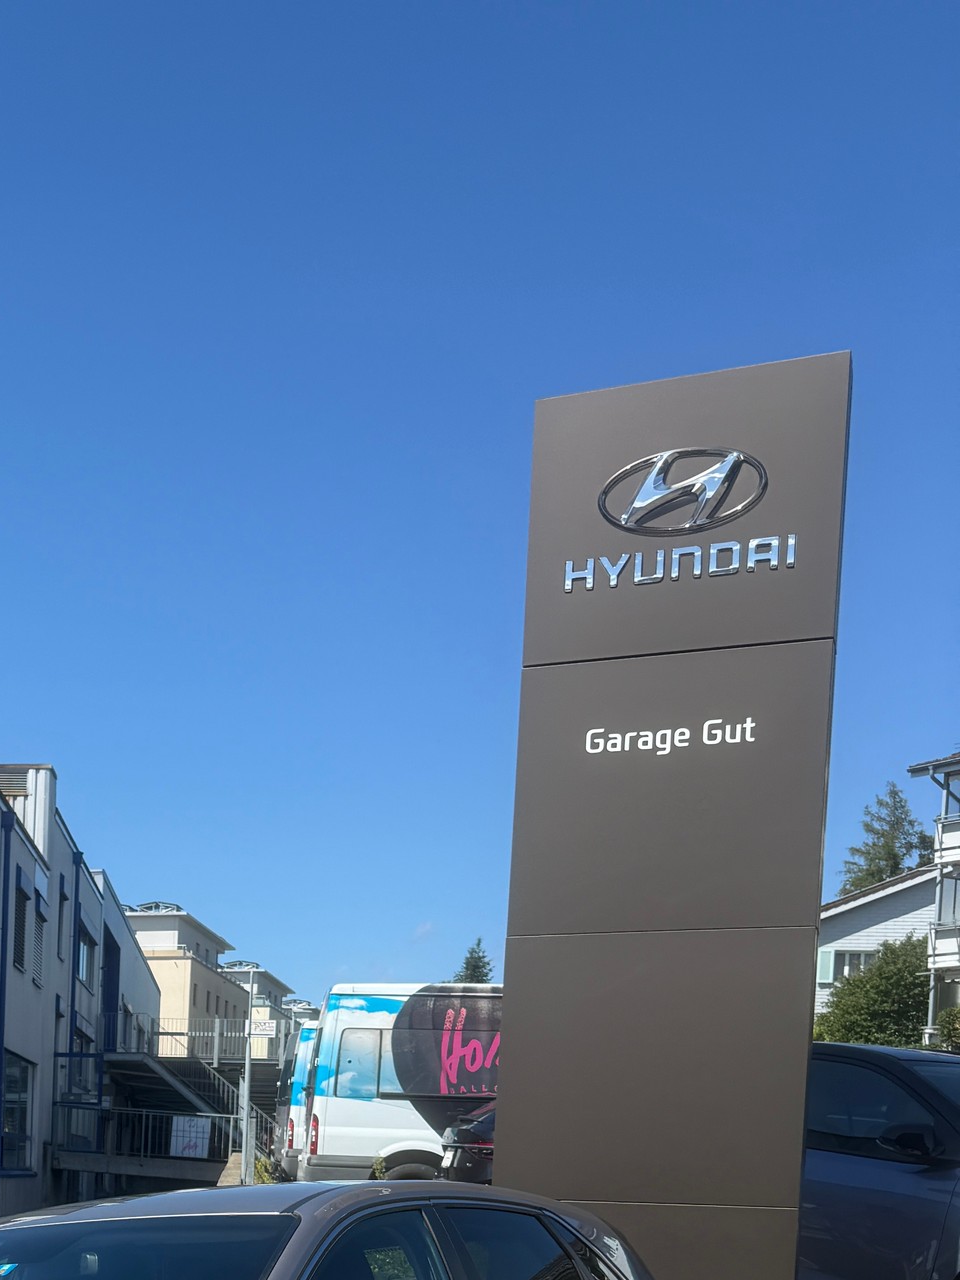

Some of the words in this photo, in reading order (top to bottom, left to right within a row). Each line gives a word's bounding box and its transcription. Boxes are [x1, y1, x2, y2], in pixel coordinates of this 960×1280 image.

[563, 533, 797, 594] HYUNDAI
[585, 727, 691, 756] Garage
[702, 717, 756, 746] Gut
